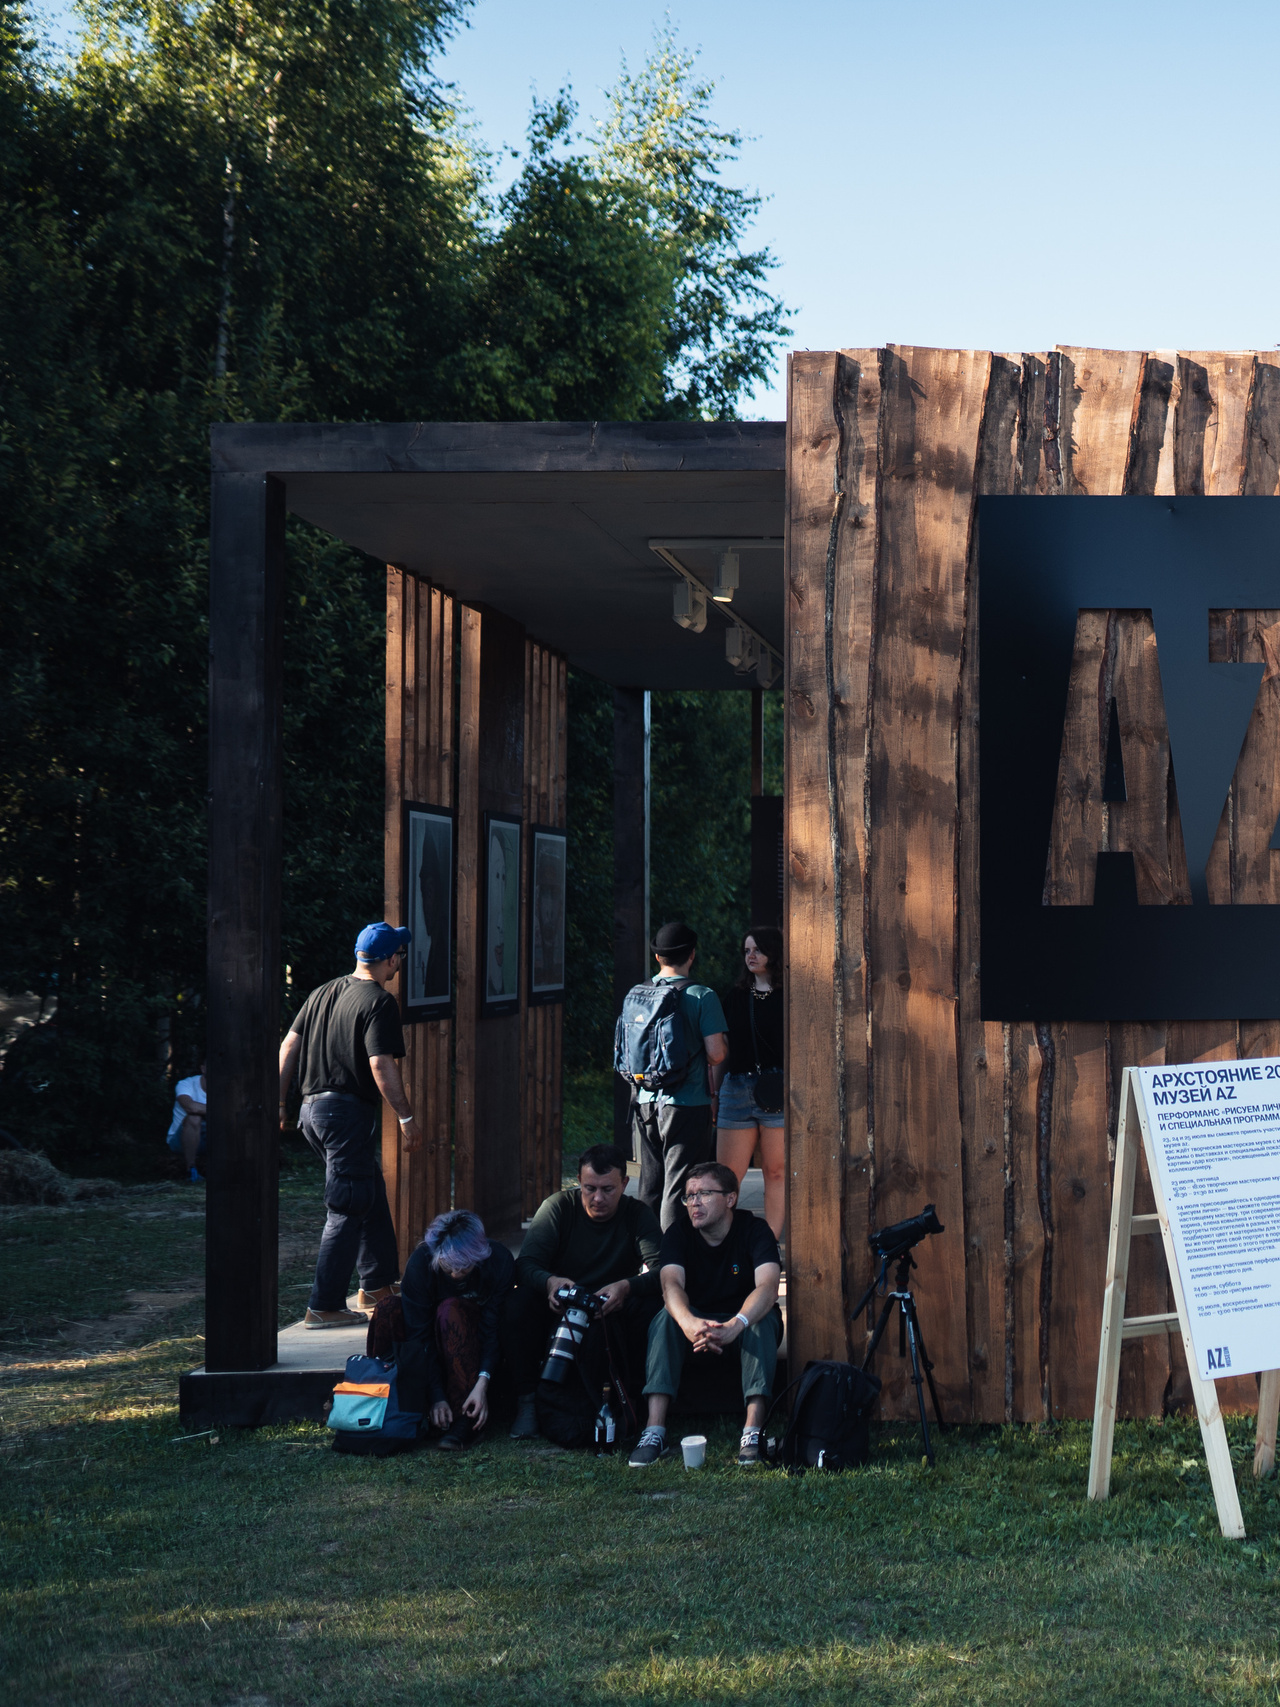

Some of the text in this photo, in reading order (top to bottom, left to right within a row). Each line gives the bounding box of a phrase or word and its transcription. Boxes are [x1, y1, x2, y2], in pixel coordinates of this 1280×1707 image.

[1152, 1066, 1263, 1088] АРХСТОЯНИЕ
[1153, 1085, 1237, 1106] МУЗЕЙ AZ
[1157, 1108, 1220, 1121] ПЕРФОРМАНС
[1159, 1123, 1166, 1131] И
[1167, 1117, 1232, 1130] СПЕЦИАЛЬНАЯ
[1207, 1348, 1225, 1369] AZ
